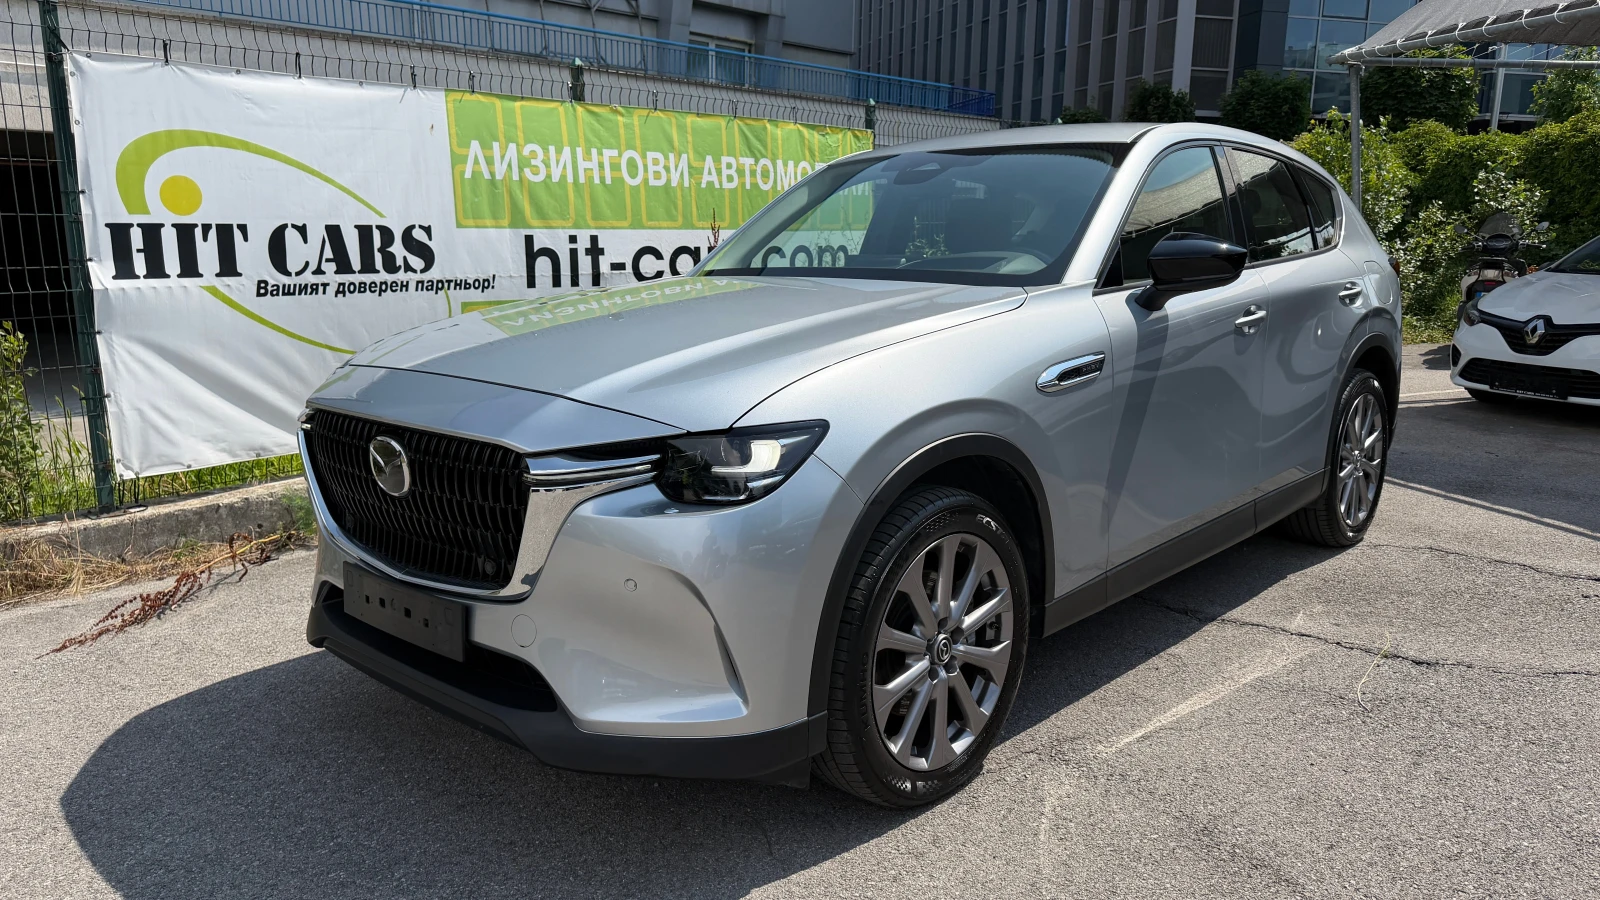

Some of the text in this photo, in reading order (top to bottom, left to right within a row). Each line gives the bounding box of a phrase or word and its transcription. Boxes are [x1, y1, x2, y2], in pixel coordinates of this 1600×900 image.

[465, 140, 690, 187] ЛИЗИНГОВИ
[105, 222, 436, 280] HIT CARS
[255, 274, 497, 298] Вашият доверен партньор!
